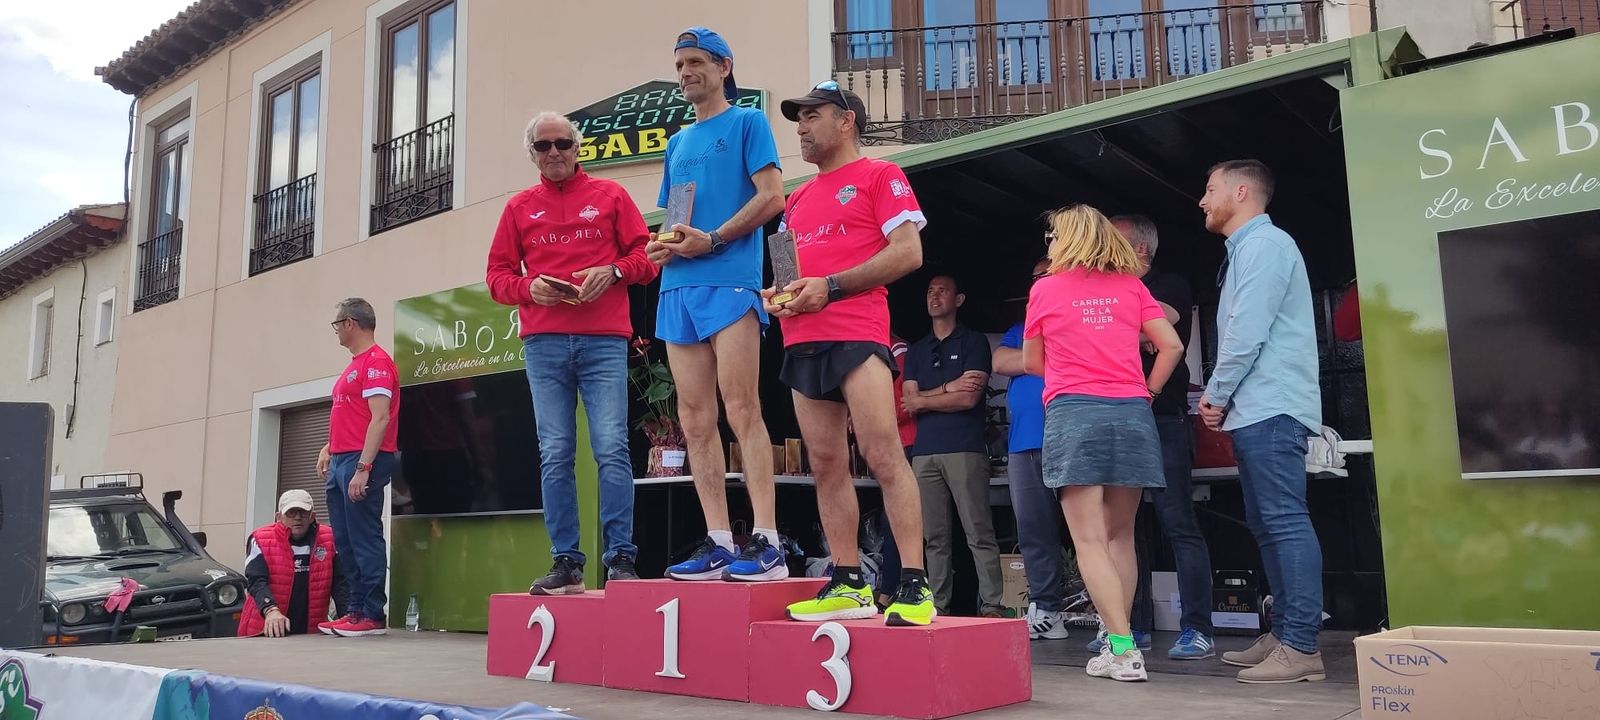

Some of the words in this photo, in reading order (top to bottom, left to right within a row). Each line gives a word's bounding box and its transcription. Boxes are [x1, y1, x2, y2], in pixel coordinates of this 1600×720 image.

[1418, 101, 1600, 180] SAB
[1425, 187, 1474, 219] La
[1072, 297, 1119, 307] CARRERA
[1098, 307, 1111, 315] LA
[1082, 315, 1113, 324] MUJER
[413, 361, 430, 378] La
[432, 358, 486, 374] Excelencia
[488, 355, 500, 364] en
[503, 350, 516, 362] la
[525, 604, 555, 682] 2
[655, 597, 686, 679] 1
[805, 621, 852, 712] 3
[1385, 653, 1429, 667] TENA
[1372, 685, 1415, 696] PROskin
[1372, 696, 1411, 713] Flex
